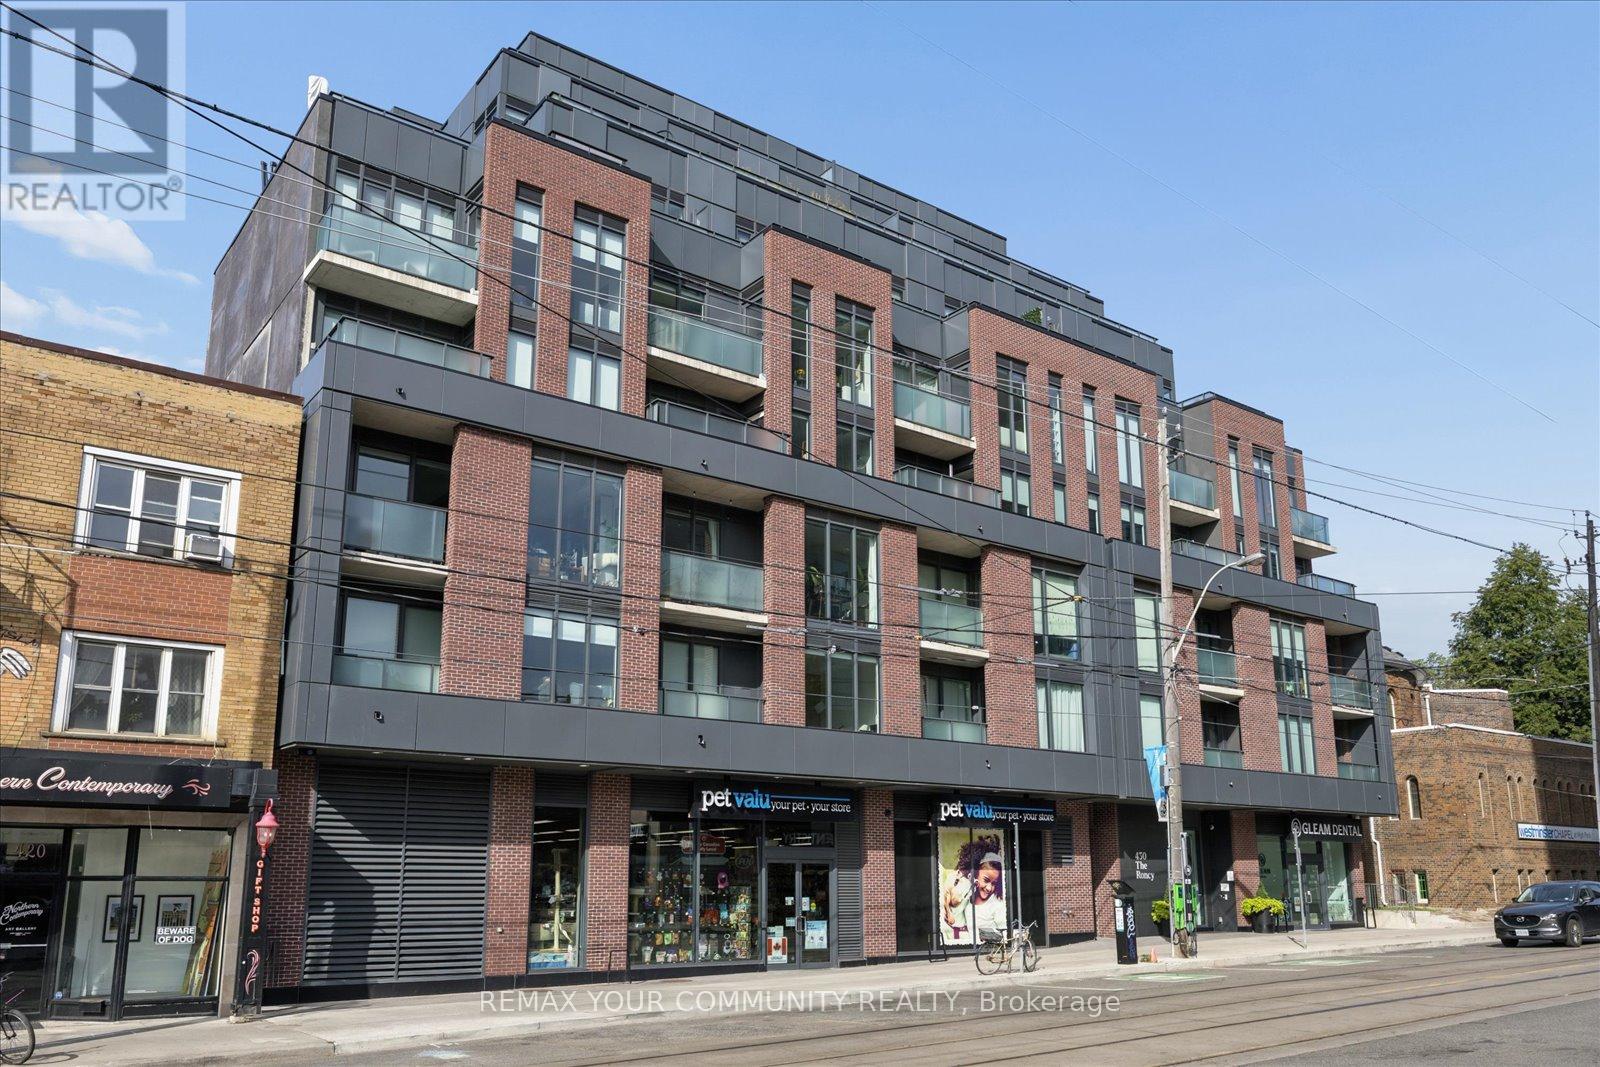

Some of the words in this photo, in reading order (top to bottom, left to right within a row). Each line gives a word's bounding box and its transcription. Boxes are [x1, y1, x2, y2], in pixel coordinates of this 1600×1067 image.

[37, 766, 173, 799] Contemporary
[701, 788, 732, 811] pet
[733, 789, 771, 809] valu
[771, 801, 790, 812] your
[792, 800, 806, 812] pet
[811, 801, 829, 813] your
[831, 802, 851, 812] store
[940, 801, 964, 821] pet
[964, 802, 993, 819] valu
[992, 810, 1007, 821] your
[1022, 812, 1037, 822] your
[1038, 813, 1054, 821] store
[1302, 823, 1331, 835] GLEAM
[1332, 825, 1362, 836] DENTAL
[17, 843, 46, 858] 420
[1135, 861, 1148, 869] The
[255, 860, 264, 895] GIFT
[1136, 870, 1155, 881] Roncy
[250, 897, 261, 933] SHOP
[157, 927, 195, 935] BEWARE
[172, 935, 194, 943] DOG
